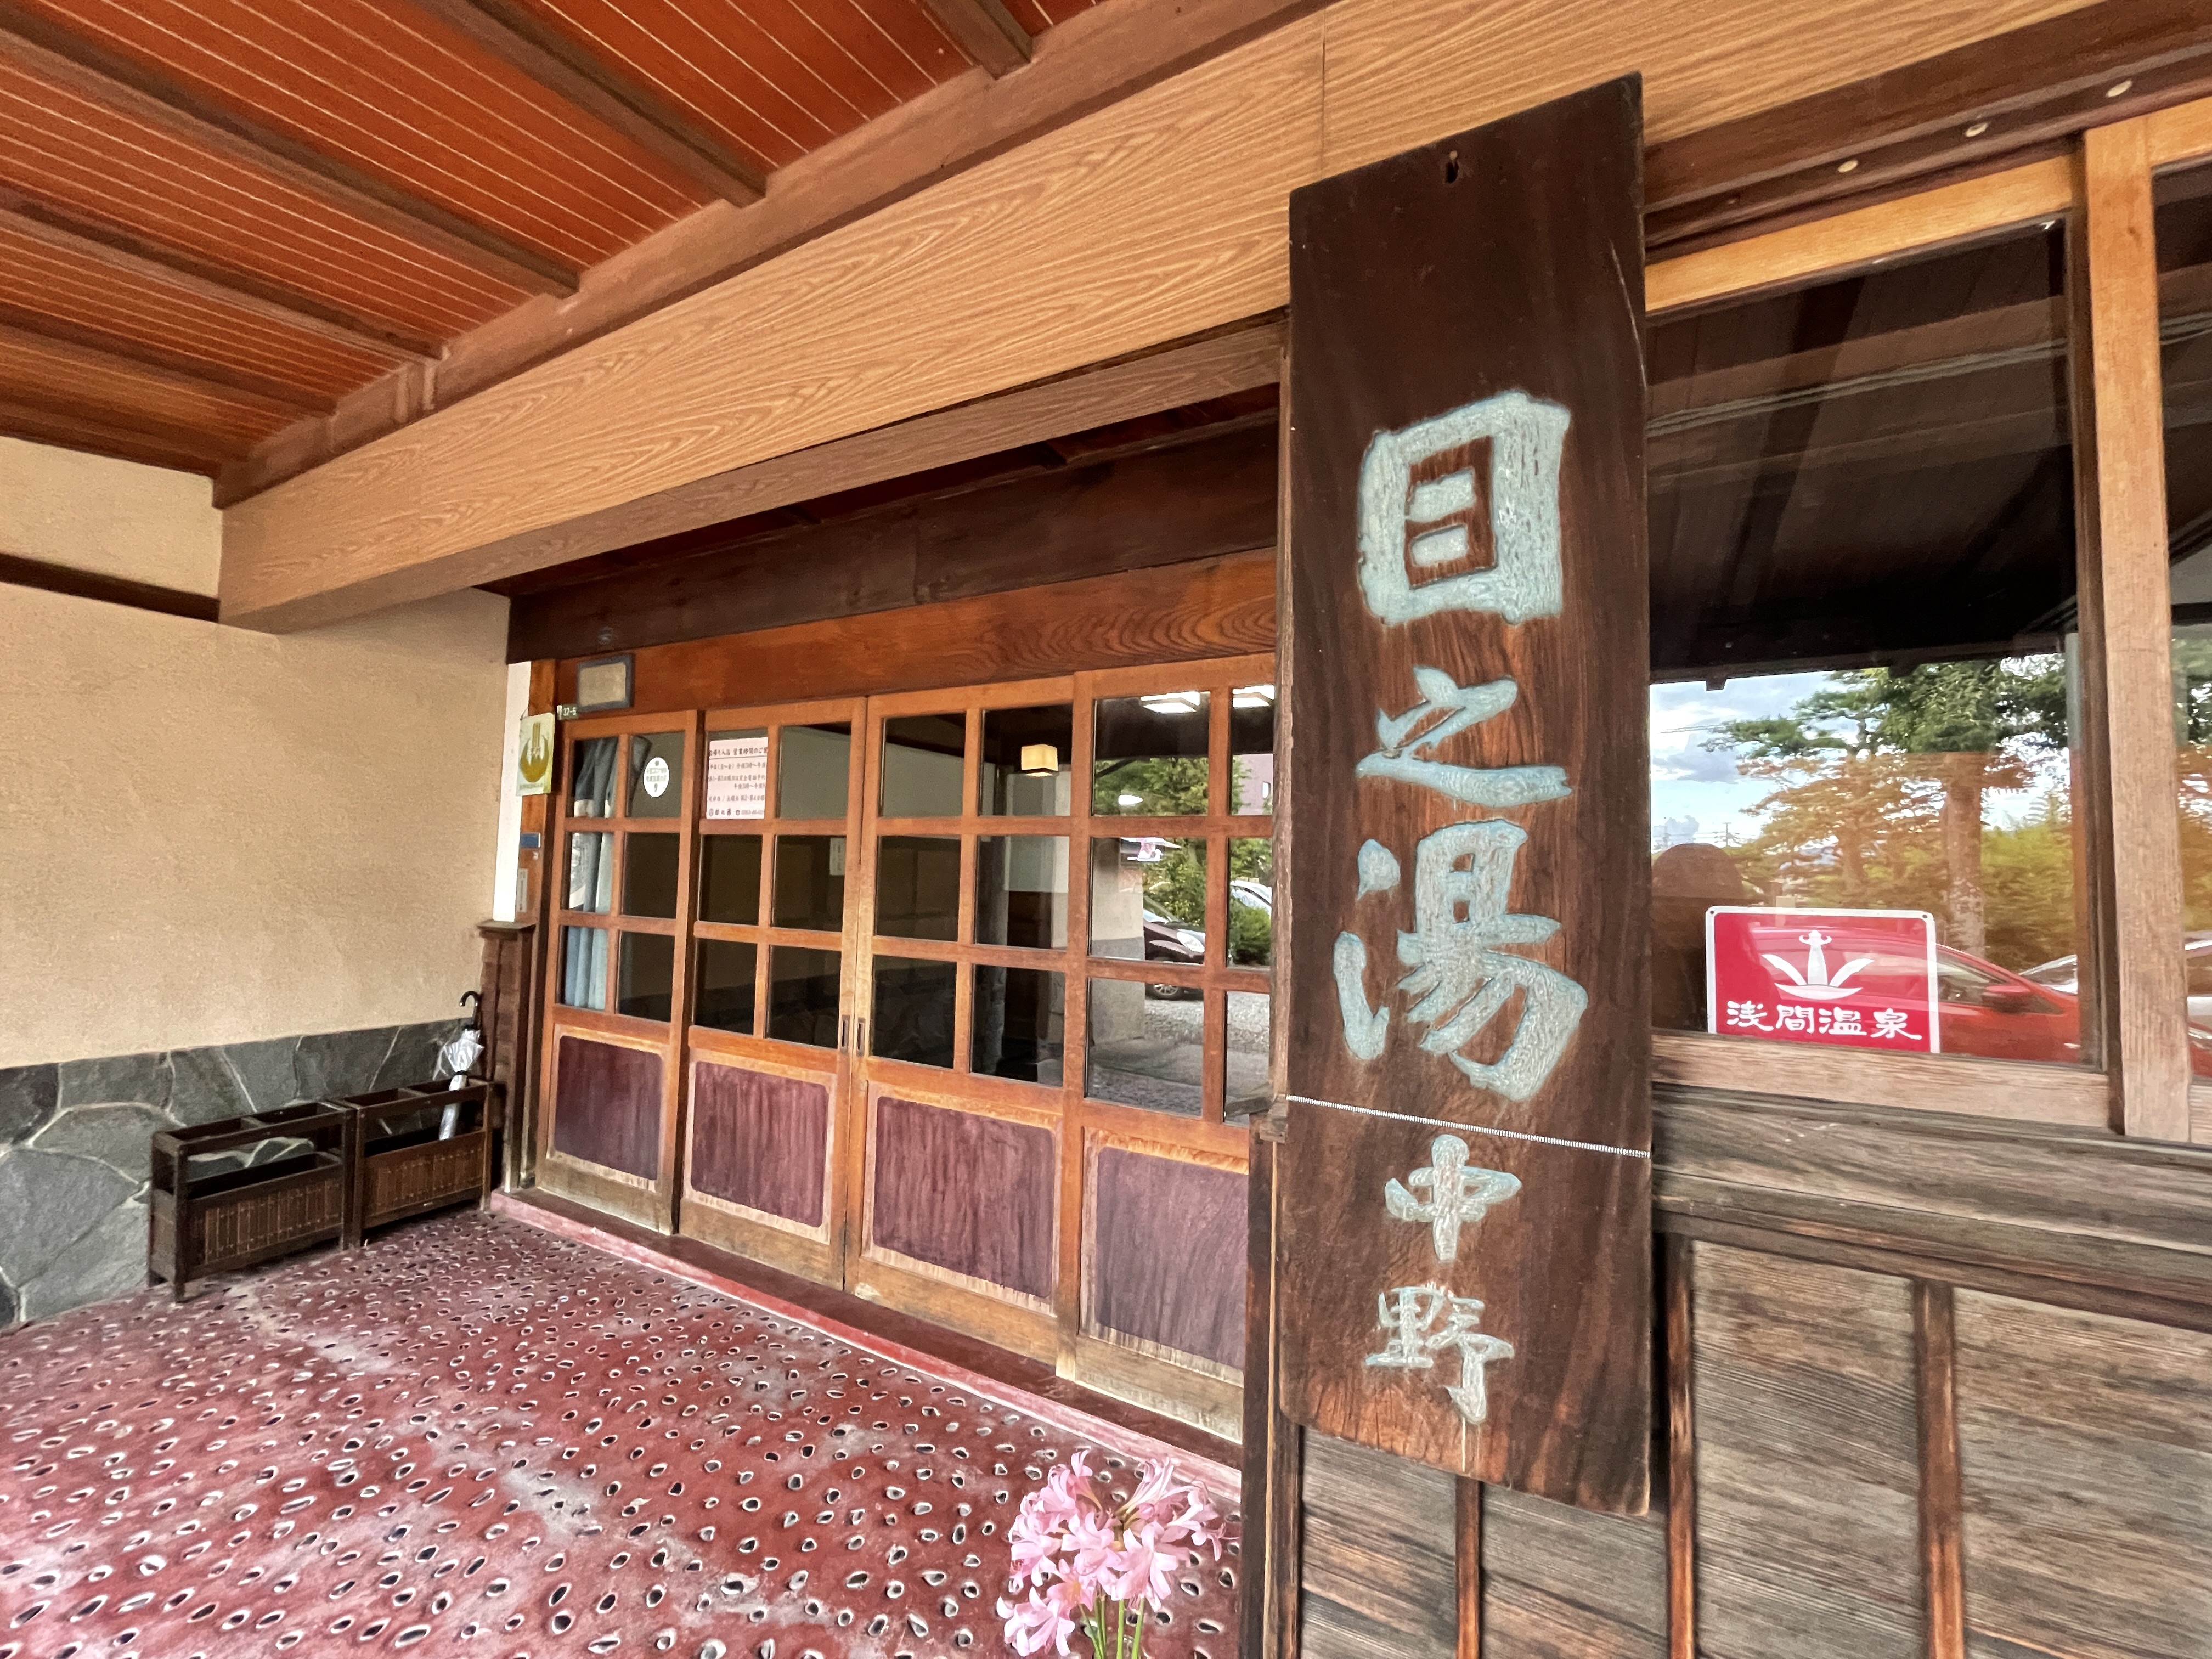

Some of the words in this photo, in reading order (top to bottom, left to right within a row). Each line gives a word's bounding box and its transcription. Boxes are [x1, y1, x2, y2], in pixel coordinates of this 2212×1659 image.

[1726, 1000, 1923, 1041] 浅間温泉
[1364, 1133, 1521, 1425] 中野
